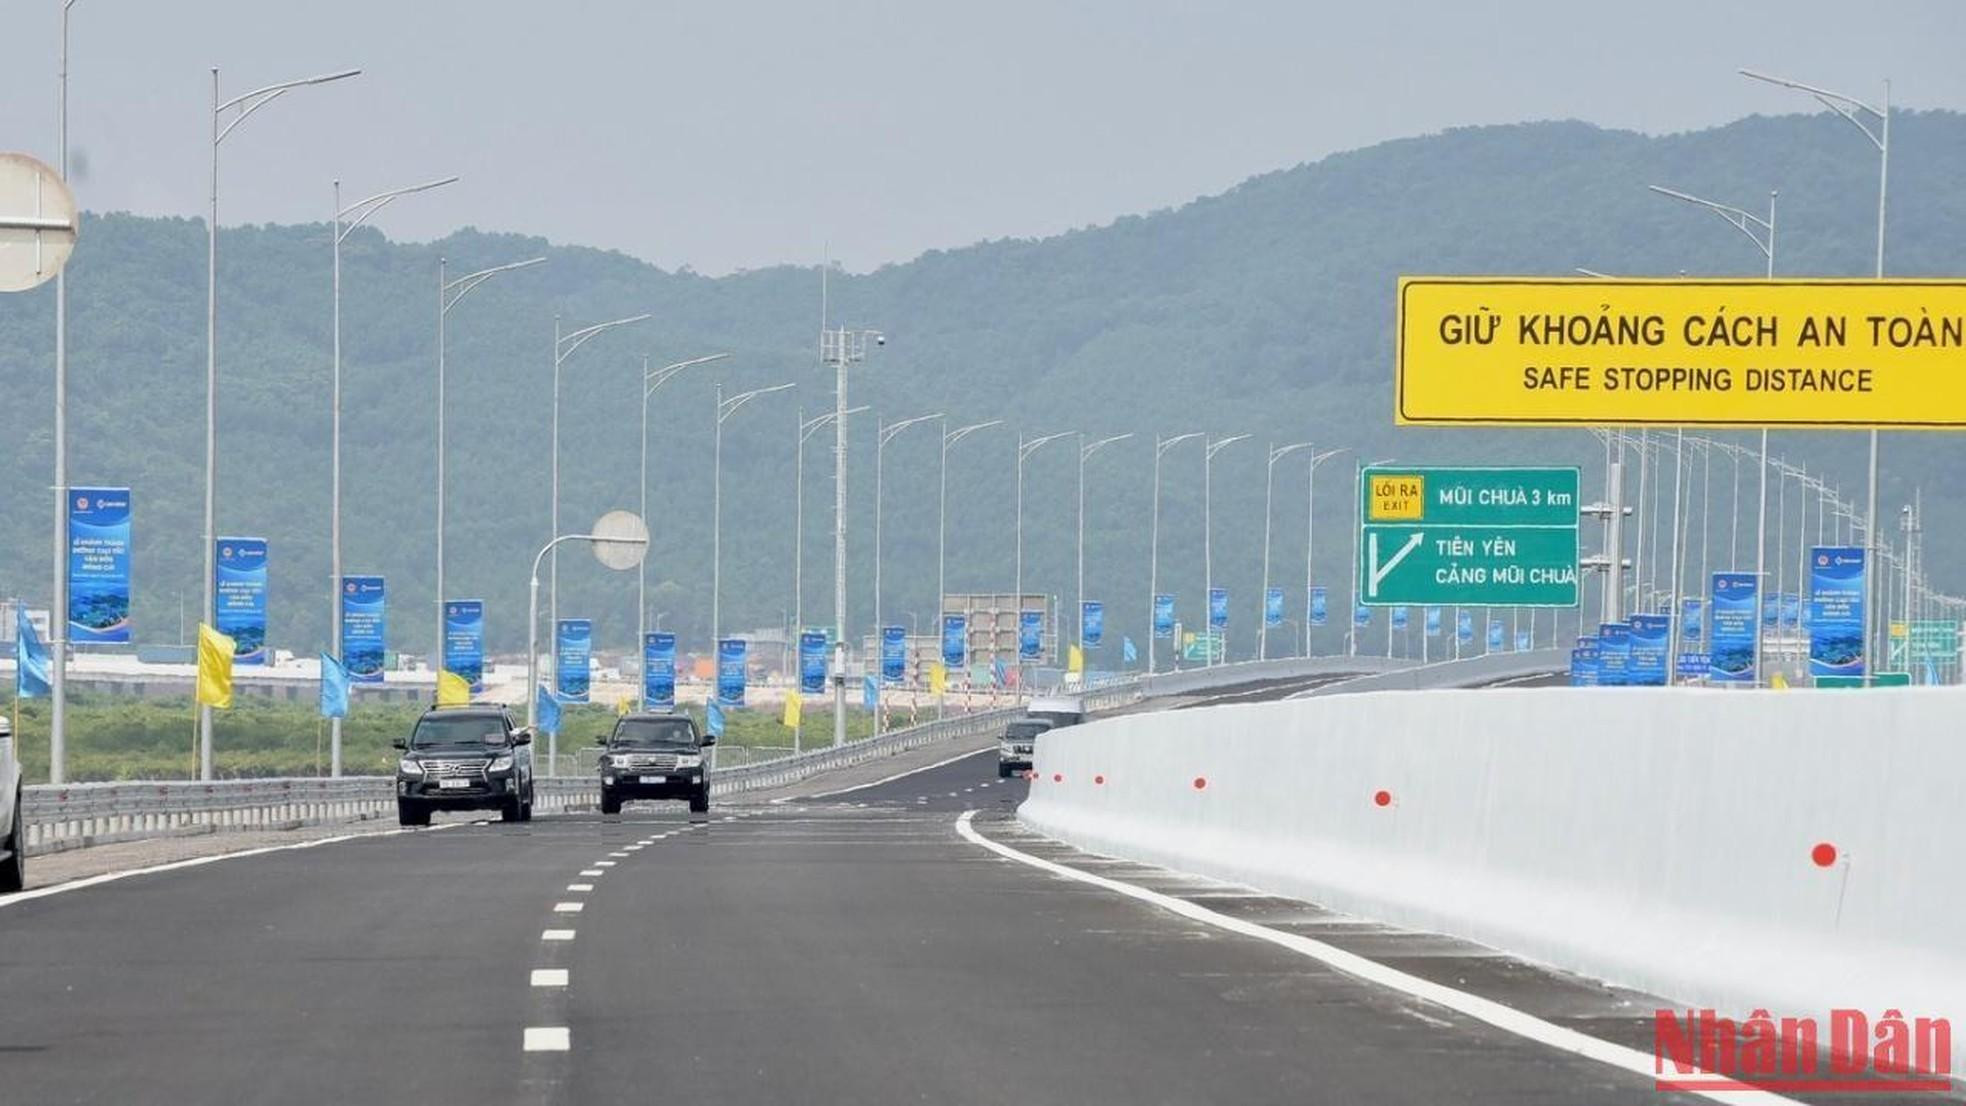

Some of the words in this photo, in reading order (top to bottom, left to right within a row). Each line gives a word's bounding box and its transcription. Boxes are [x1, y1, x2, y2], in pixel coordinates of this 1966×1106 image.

[1439, 306, 1501, 345] GIỮ
[1519, 304, 1665, 346] KHOẢNG
[1683, 306, 1778, 347] CÁCH
[1797, 316, 1846, 347] AN
[1866, 307, 1963, 348] TOÀN
[1523, 367, 1590, 390] SAFE
[1603, 367, 1732, 392] STOPPING
[1746, 369, 1873, 392] DISTANCE
[1400, 484, 1418, 497] RA
[1440, 485, 1472, 505] MŨI
[1531, 489, 1541, 505] 3
[1547, 489, 1572, 505] km
[1383, 501, 1408, 511] EXIT
[1435, 535, 1474, 556] TIÊN
[1481, 535, 1516, 556] YÊN
[1435, 562, 1487, 584] CẢNG
[1493, 564, 1525, 584] MŨI
